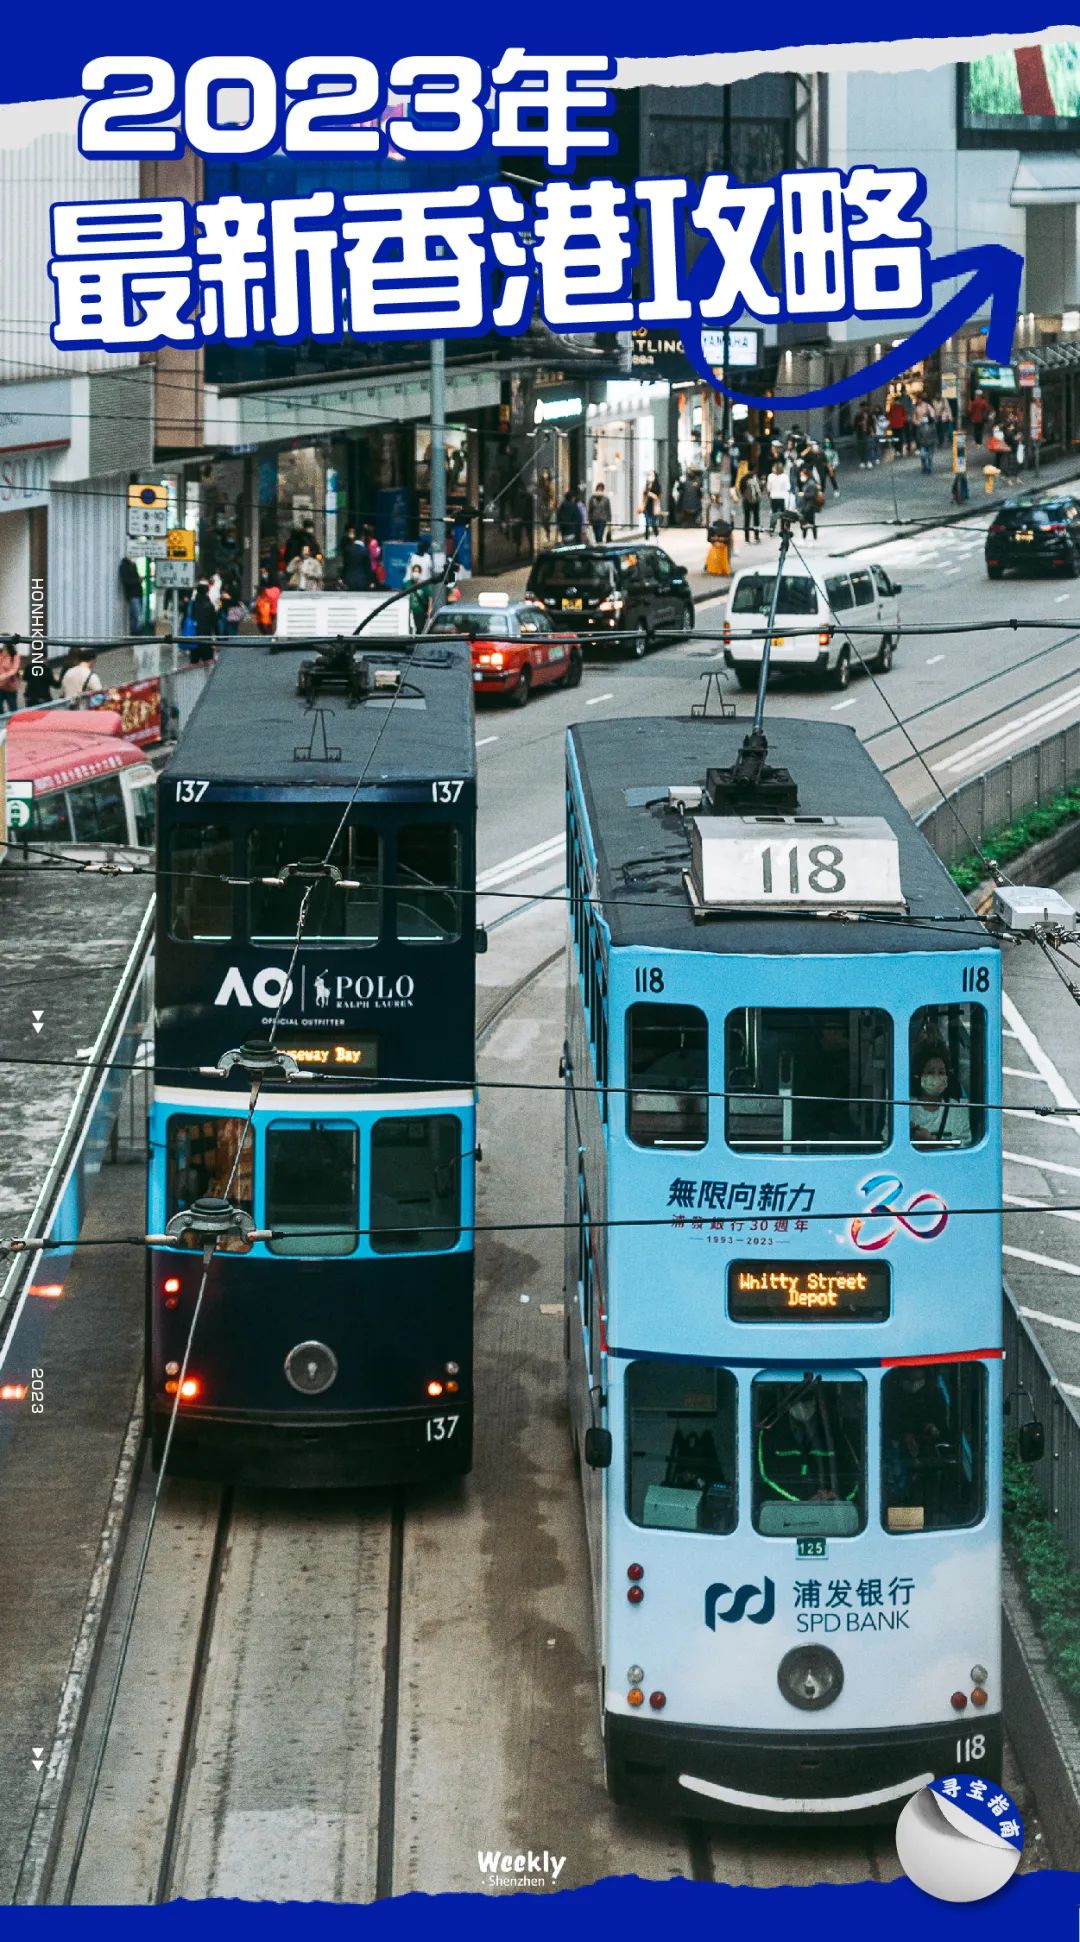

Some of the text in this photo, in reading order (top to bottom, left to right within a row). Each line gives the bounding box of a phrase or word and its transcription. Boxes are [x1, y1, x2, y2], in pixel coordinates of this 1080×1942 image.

[176, 780, 210, 803] 137
[432, 780, 464, 803] 137
[761, 844, 847, 894] 118
[336, 975, 414, 999] POLO
[635, 967, 665, 993] 118
[962, 966, 990, 993] 118
[375, 1000, 414, 1008] LAUREN
[301, 1018, 345, 1026] OUTFITTER
[335, 1046, 361, 1063] Bay
[667, 1177, 815, 1212] 無限向新力
[739, 1273, 867, 1292] Whitty Street
[788, 1290, 838, 1308] Depot
[427, 1416, 459, 1442] 137
[799, 1542, 823, 1555] 125
[792, 1576, 915, 1609] 浦发银行
[796, 1609, 910, 1633] SPD BANK
[956, 1734, 986, 1763] 118
